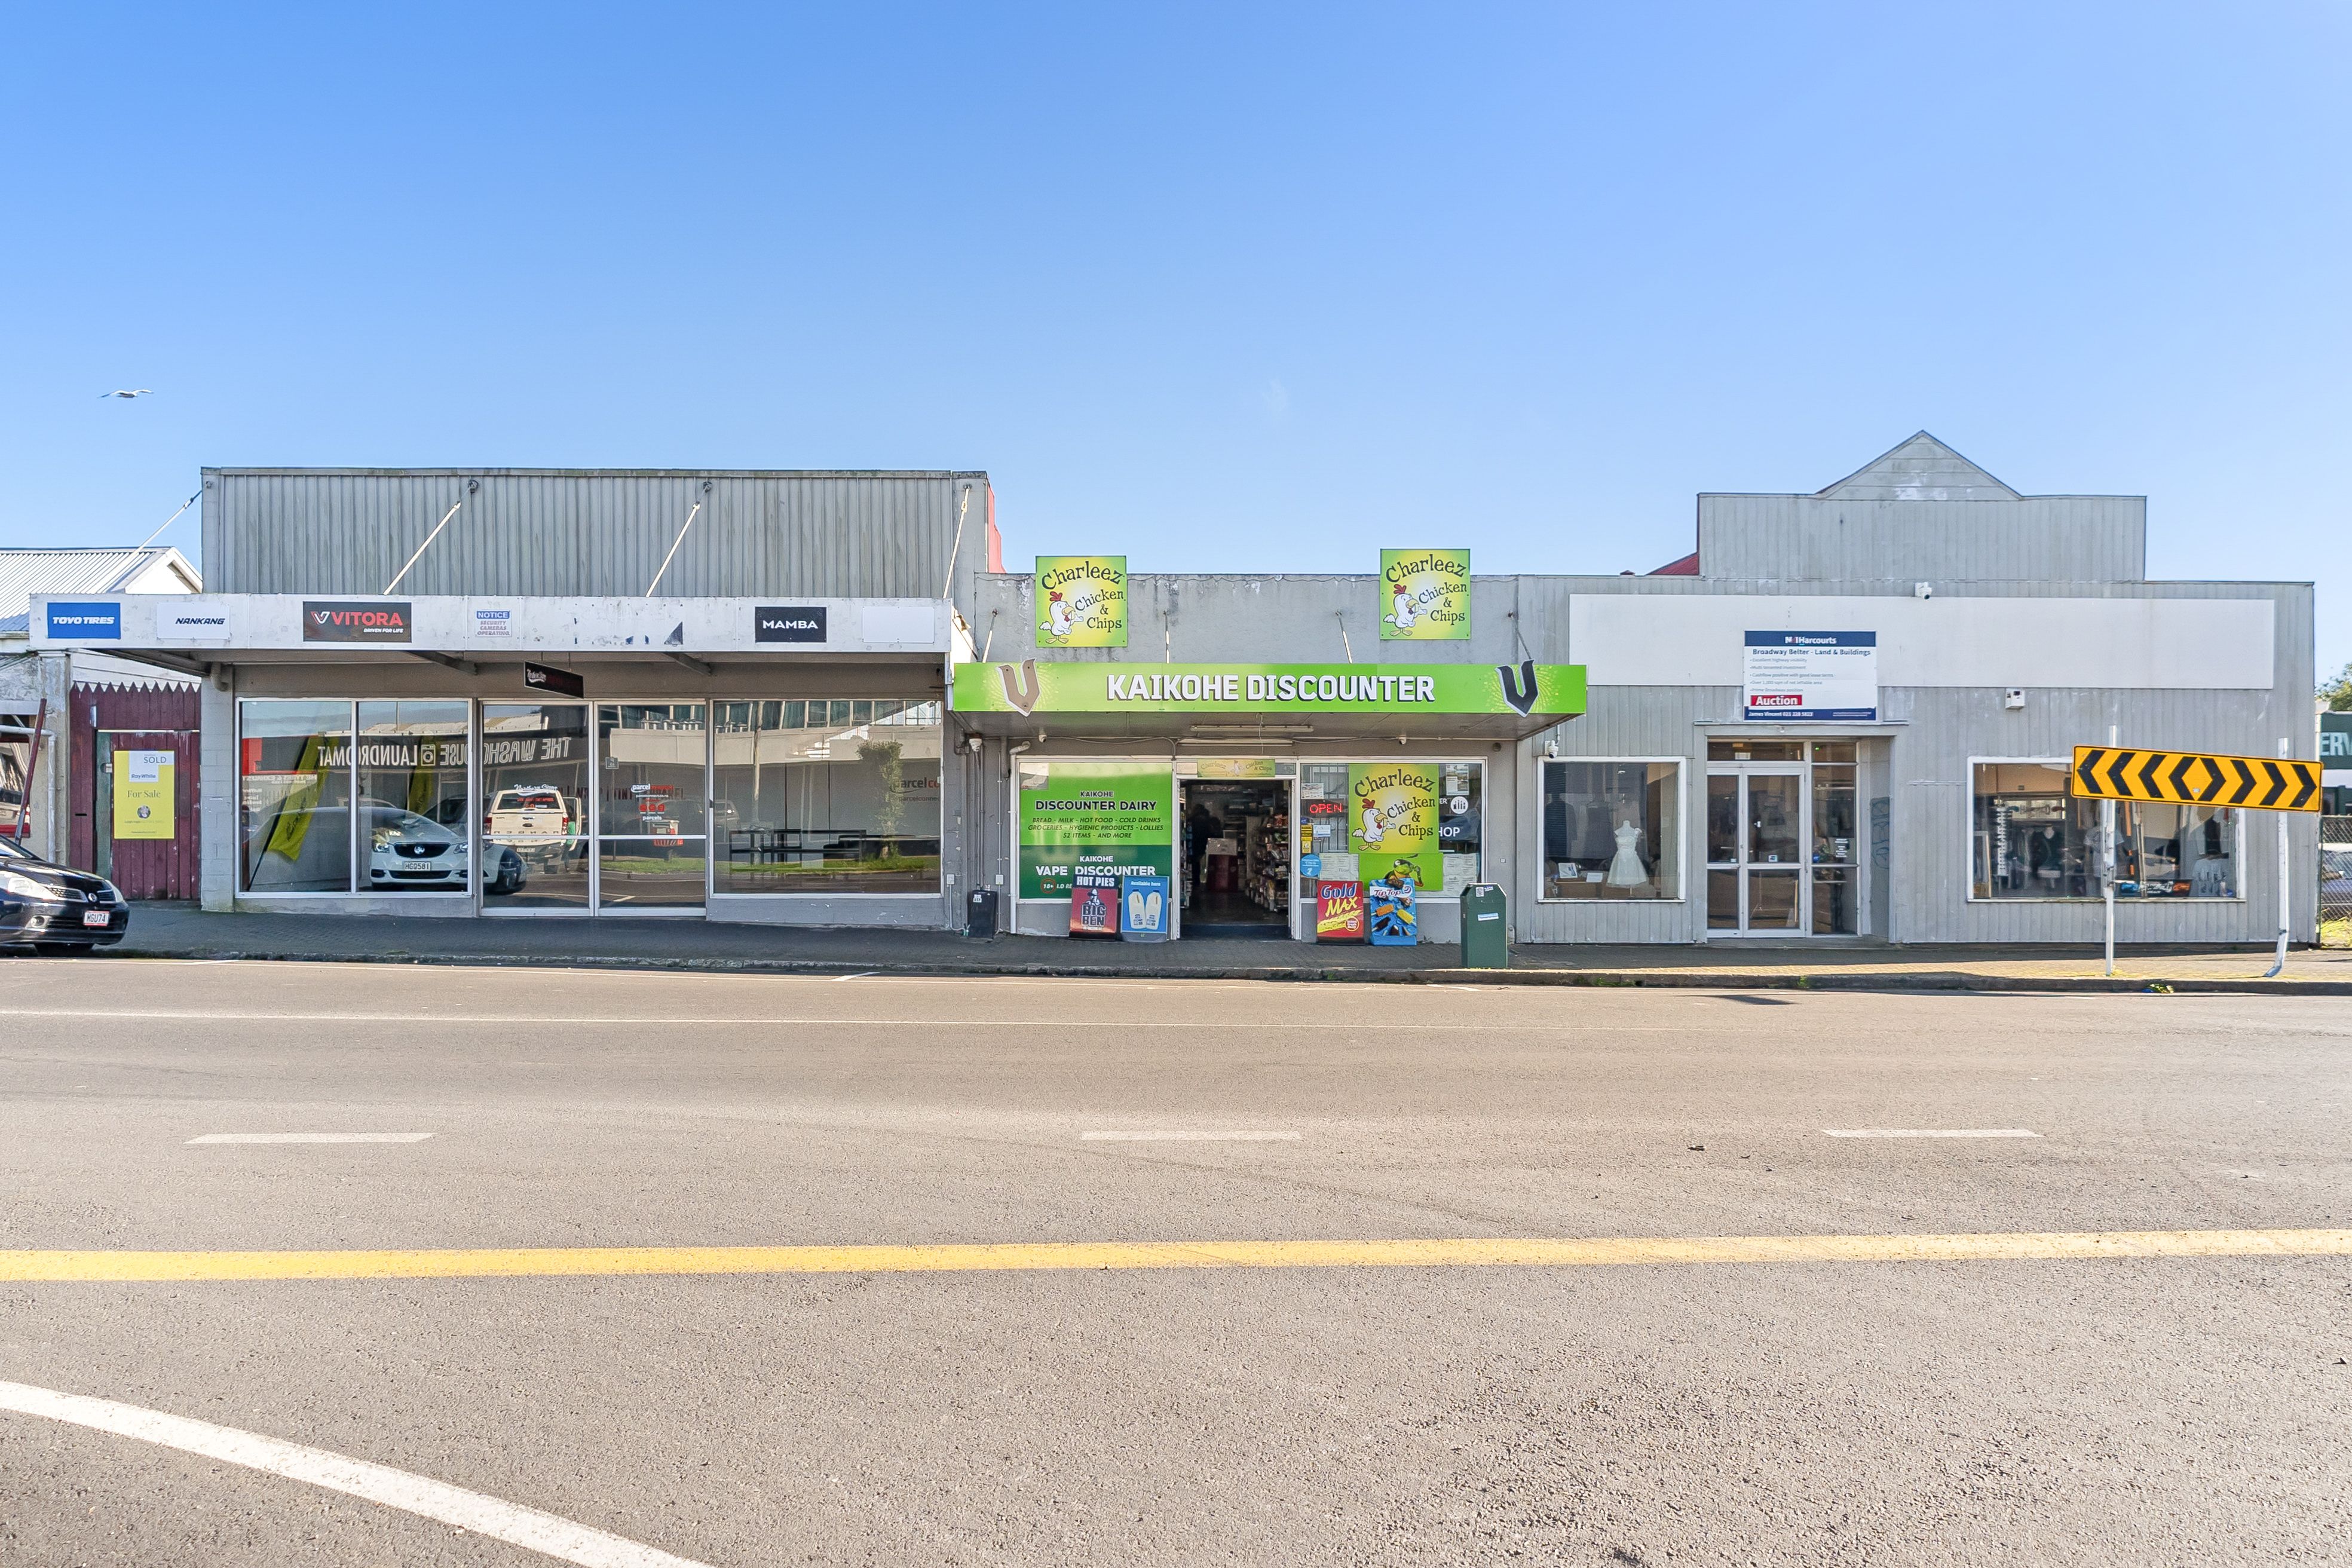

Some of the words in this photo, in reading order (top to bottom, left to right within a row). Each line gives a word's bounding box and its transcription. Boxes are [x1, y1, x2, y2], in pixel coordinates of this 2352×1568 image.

[1042, 561, 1123, 589] Charleez
[1386, 554, 1466, 582] Charleez
[1075, 589, 1123, 611] Chicken
[1419, 582, 1467, 604] Chicken
[1100, 604, 1108, 614] &
[1443, 597, 1451, 607] &
[331, 611, 403, 626] VITORA
[762, 620, 819, 629] MAMBA
[1087, 617, 1122, 632] Chips
[1431, 610, 1465, 625] Chips
[1107, 675, 1239, 700] KAIKOHE
[1247, 675, 1435, 702] DISCOUNTER
[1756, 696, 1798, 705] Auction
[1355, 768, 1435, 797] Charleez
[1036, 801, 1116, 810] DISCOUNTER
[1120, 801, 1157, 810] DAIRY
[1310, 803, 1343, 813] OPEN
[1387, 797, 1435, 818] Chicken
[1411, 811, 1420, 822] &
[1398, 825, 1433, 840] Chips
[1036, 866, 1068, 875] VAPE
[1075, 866, 1156, 876] DISCOUNTER
[1077, 877, 1093, 886] HOT
[1095, 877, 1114, 887] PIES
[1321, 883, 1358, 899] Gold
[1082, 905, 1106, 916] BIG
[1325, 896, 1358, 917] MAX
[1082, 916, 1105, 926] BEN
